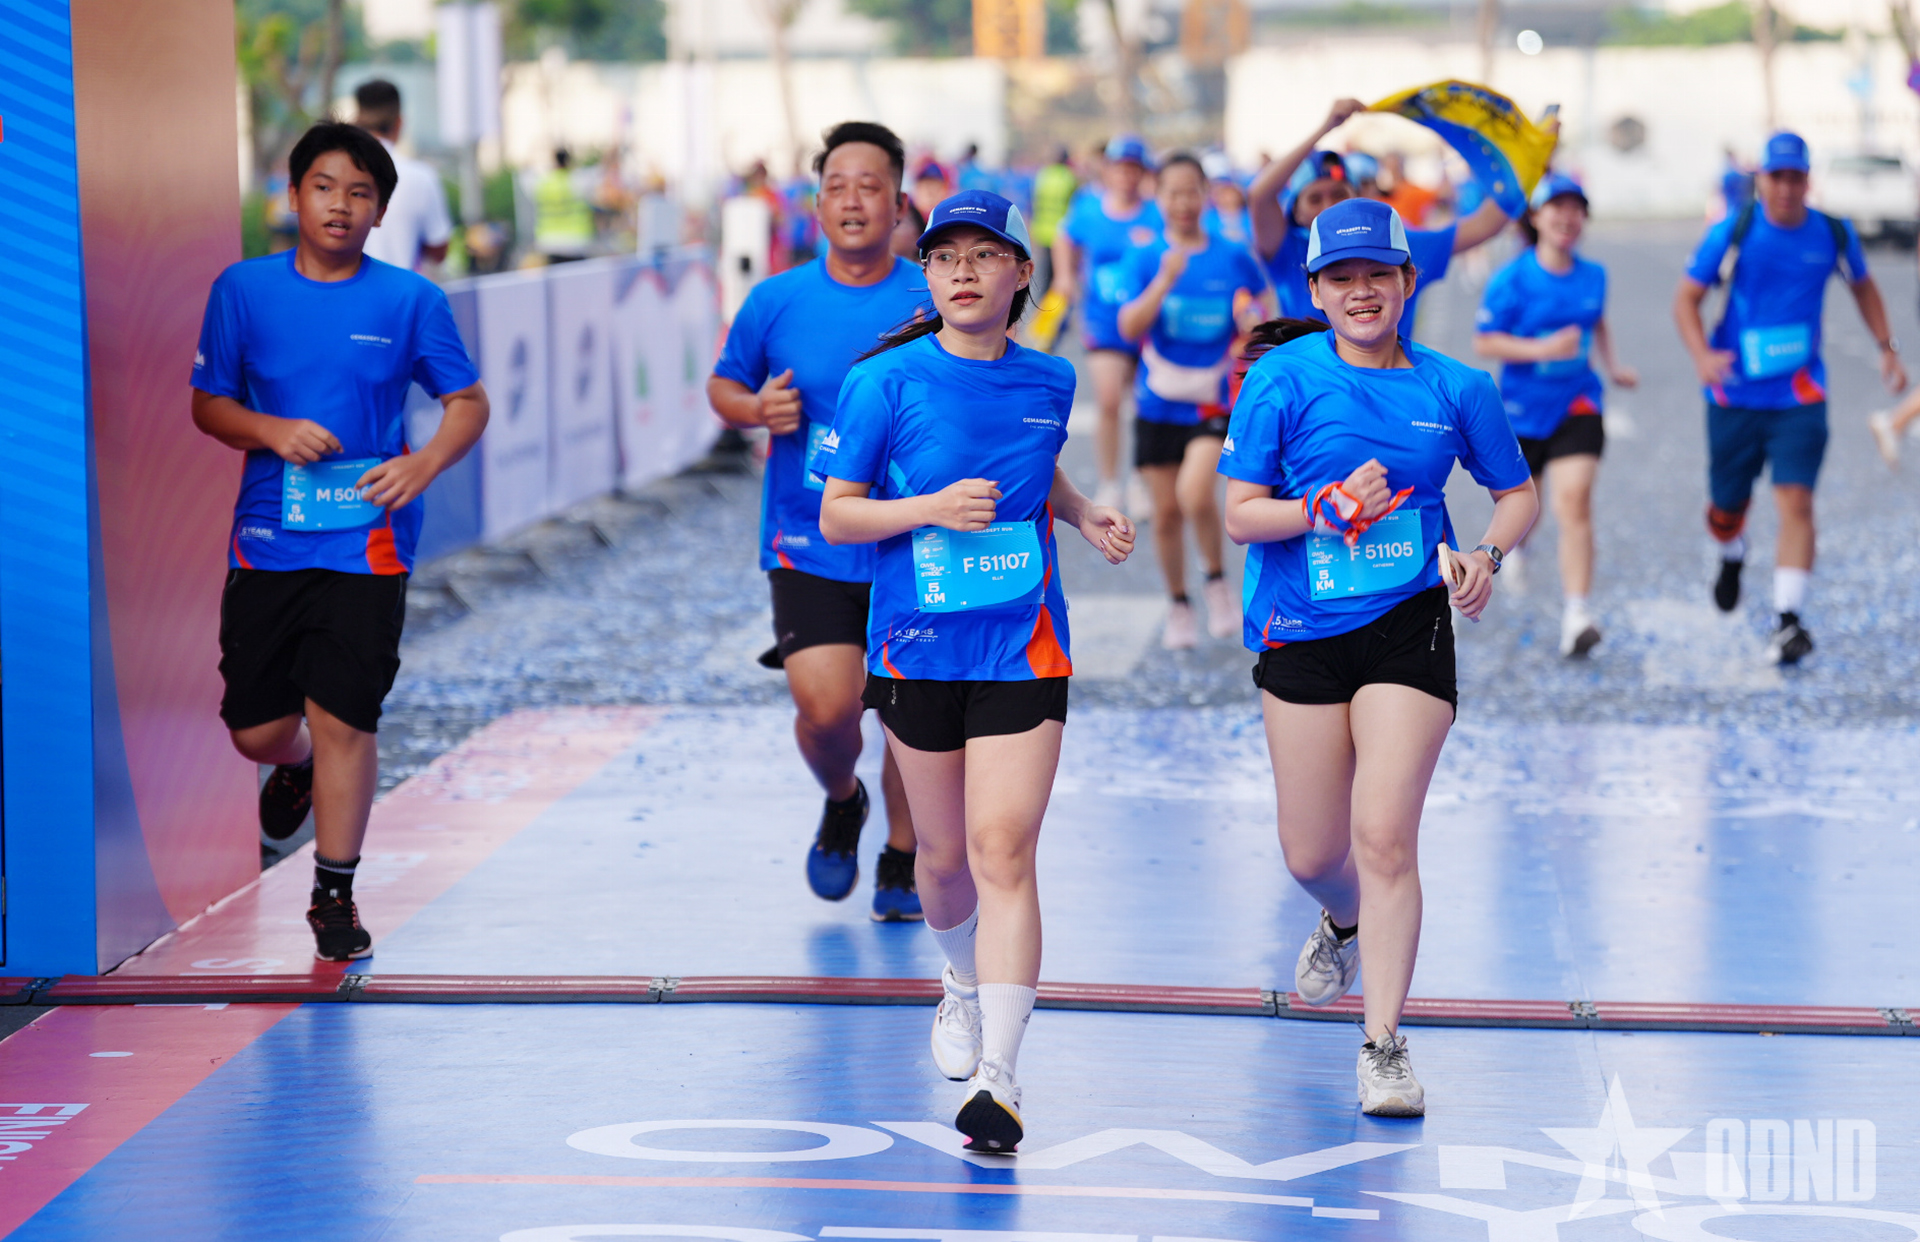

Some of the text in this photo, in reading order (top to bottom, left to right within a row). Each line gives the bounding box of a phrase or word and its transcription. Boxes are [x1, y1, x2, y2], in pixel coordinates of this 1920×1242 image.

[316, 488, 331, 502] M
[287, 513, 305, 523] KM
[1350, 541, 1413, 561] F 51105
[962, 551, 1031, 574] F 51107
[1318, 569, 1330, 580] 5
[928, 582, 940, 592] 5
[1316, 579, 1334, 591] KM
[924, 593, 946, 604] KM
